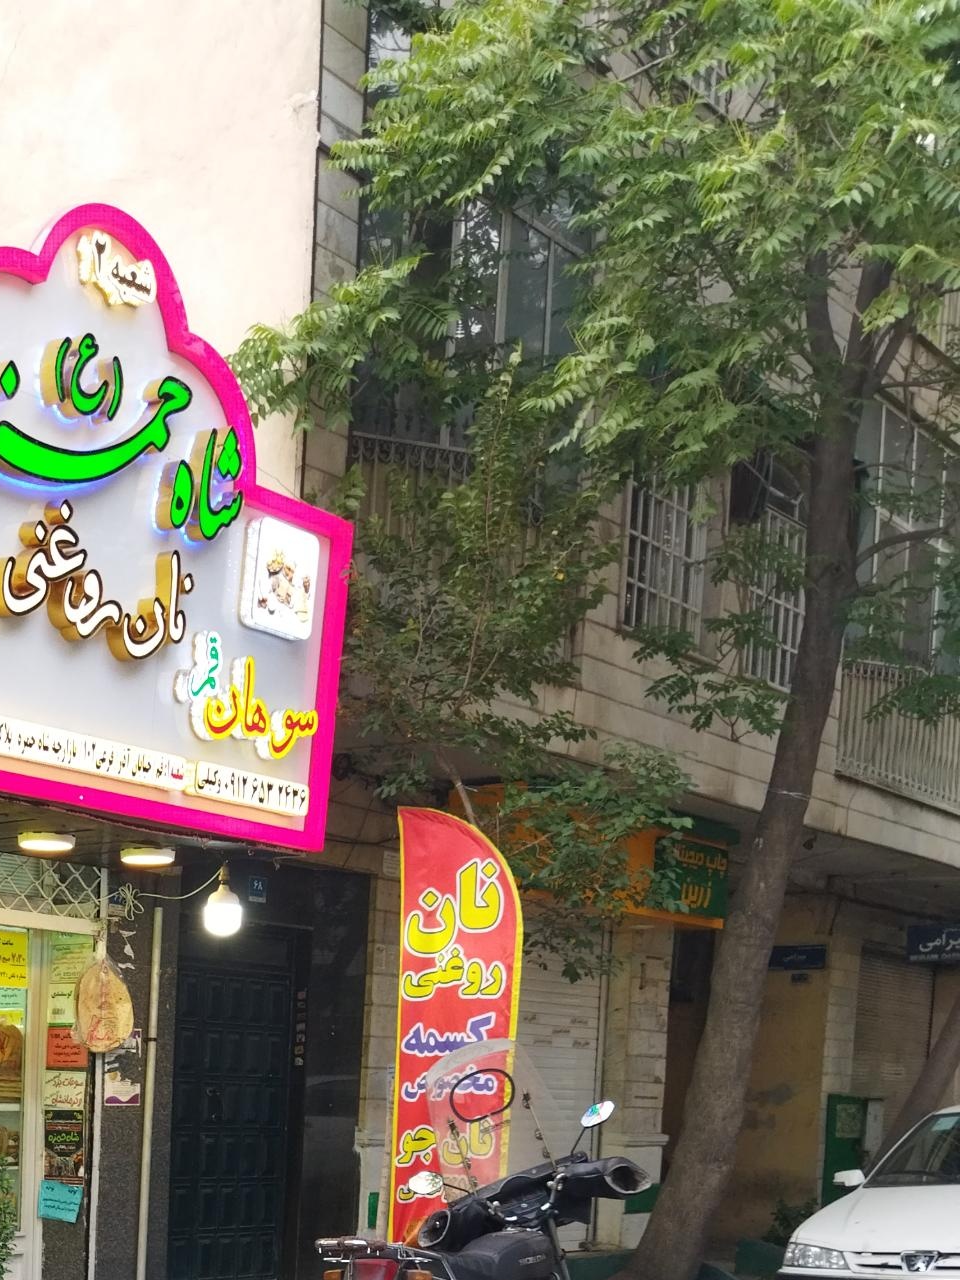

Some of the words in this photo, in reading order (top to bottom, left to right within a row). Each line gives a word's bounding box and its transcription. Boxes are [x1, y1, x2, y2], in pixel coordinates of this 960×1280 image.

[95, 239, 107, 273] ۲
[111, 261, 152, 297] شعبه
[171, 427, 244, 542] شاه
[1, 500, 123, 638] روغنی
[123, 551, 194, 658] نان
[191, 634, 220, 698] قم
[205, 656, 319, 759] سوهان
[406, 860, 502, 955] نان
[402, 946, 503, 999] روغنی
[403, 1014, 494, 1055] کسمه
[396, 1127, 437, 1165] جو
[441, 1118, 494, 1166] نان
